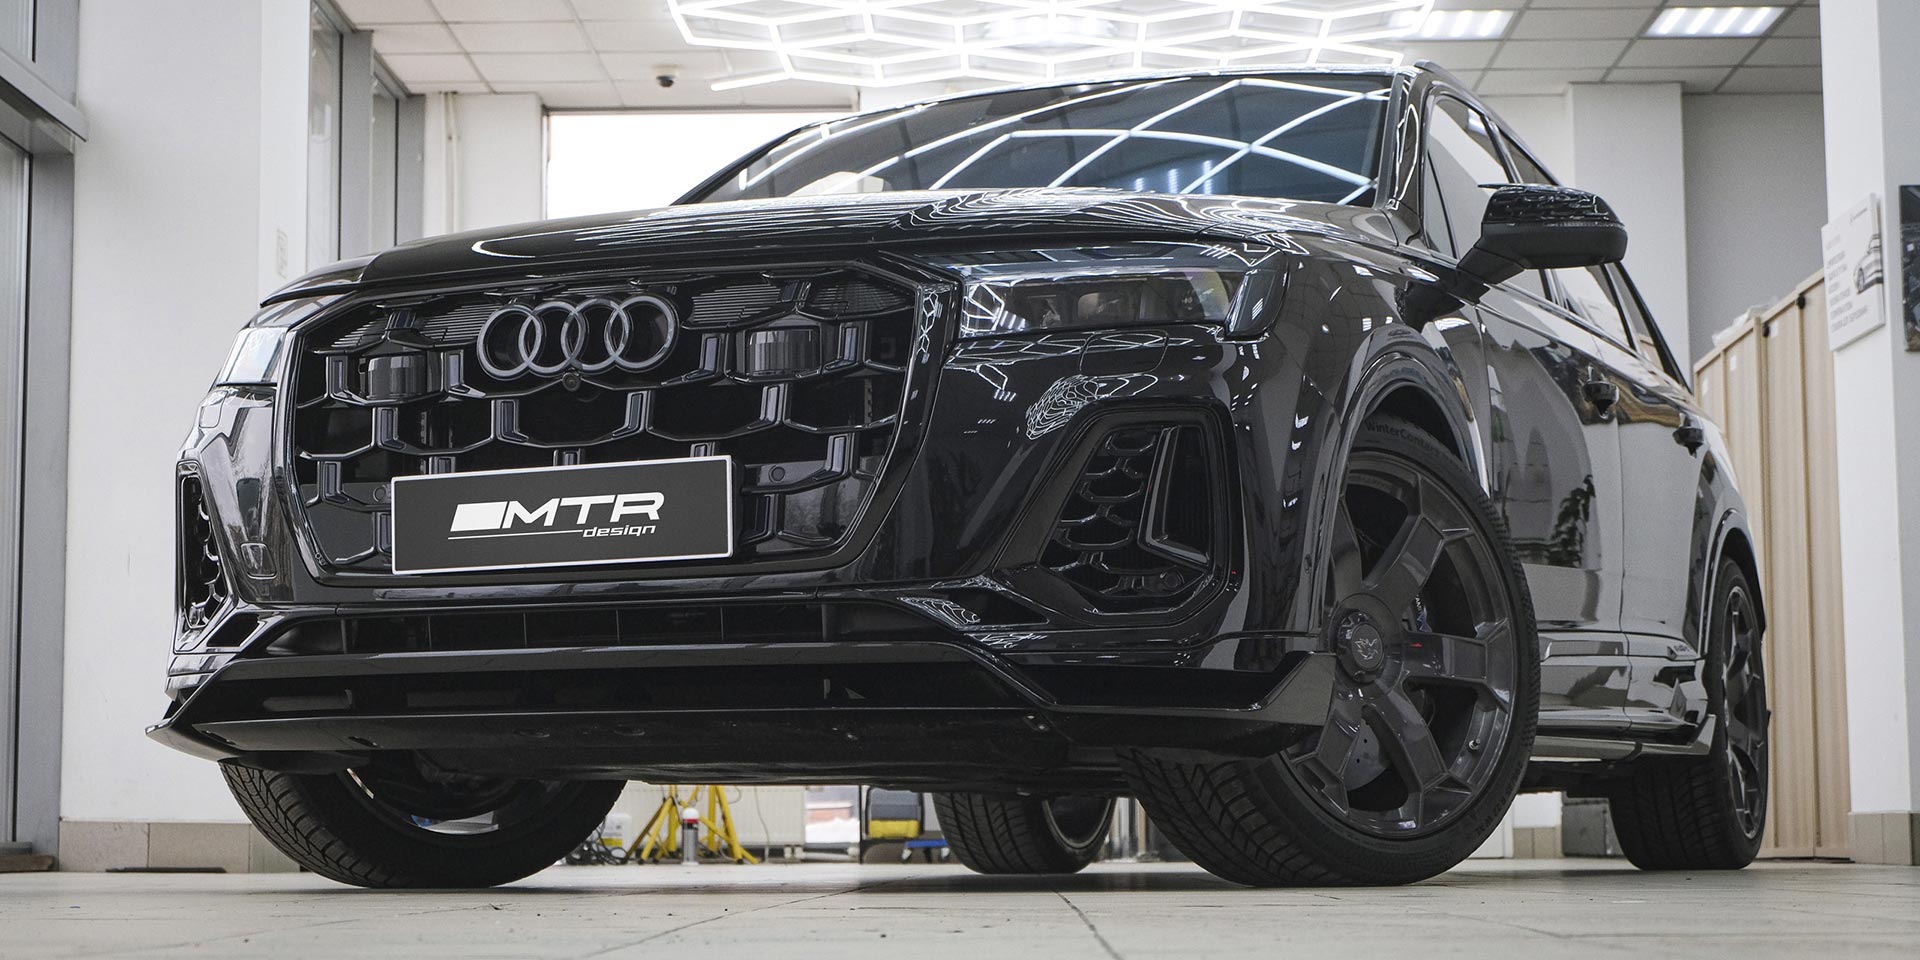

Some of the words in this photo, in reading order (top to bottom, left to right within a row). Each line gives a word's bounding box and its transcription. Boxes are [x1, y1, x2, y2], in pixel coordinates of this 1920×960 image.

[1364, 421, 1440, 457] WinterCont
[502, 492, 664, 529] MTR
[582, 525, 656, 538] design
